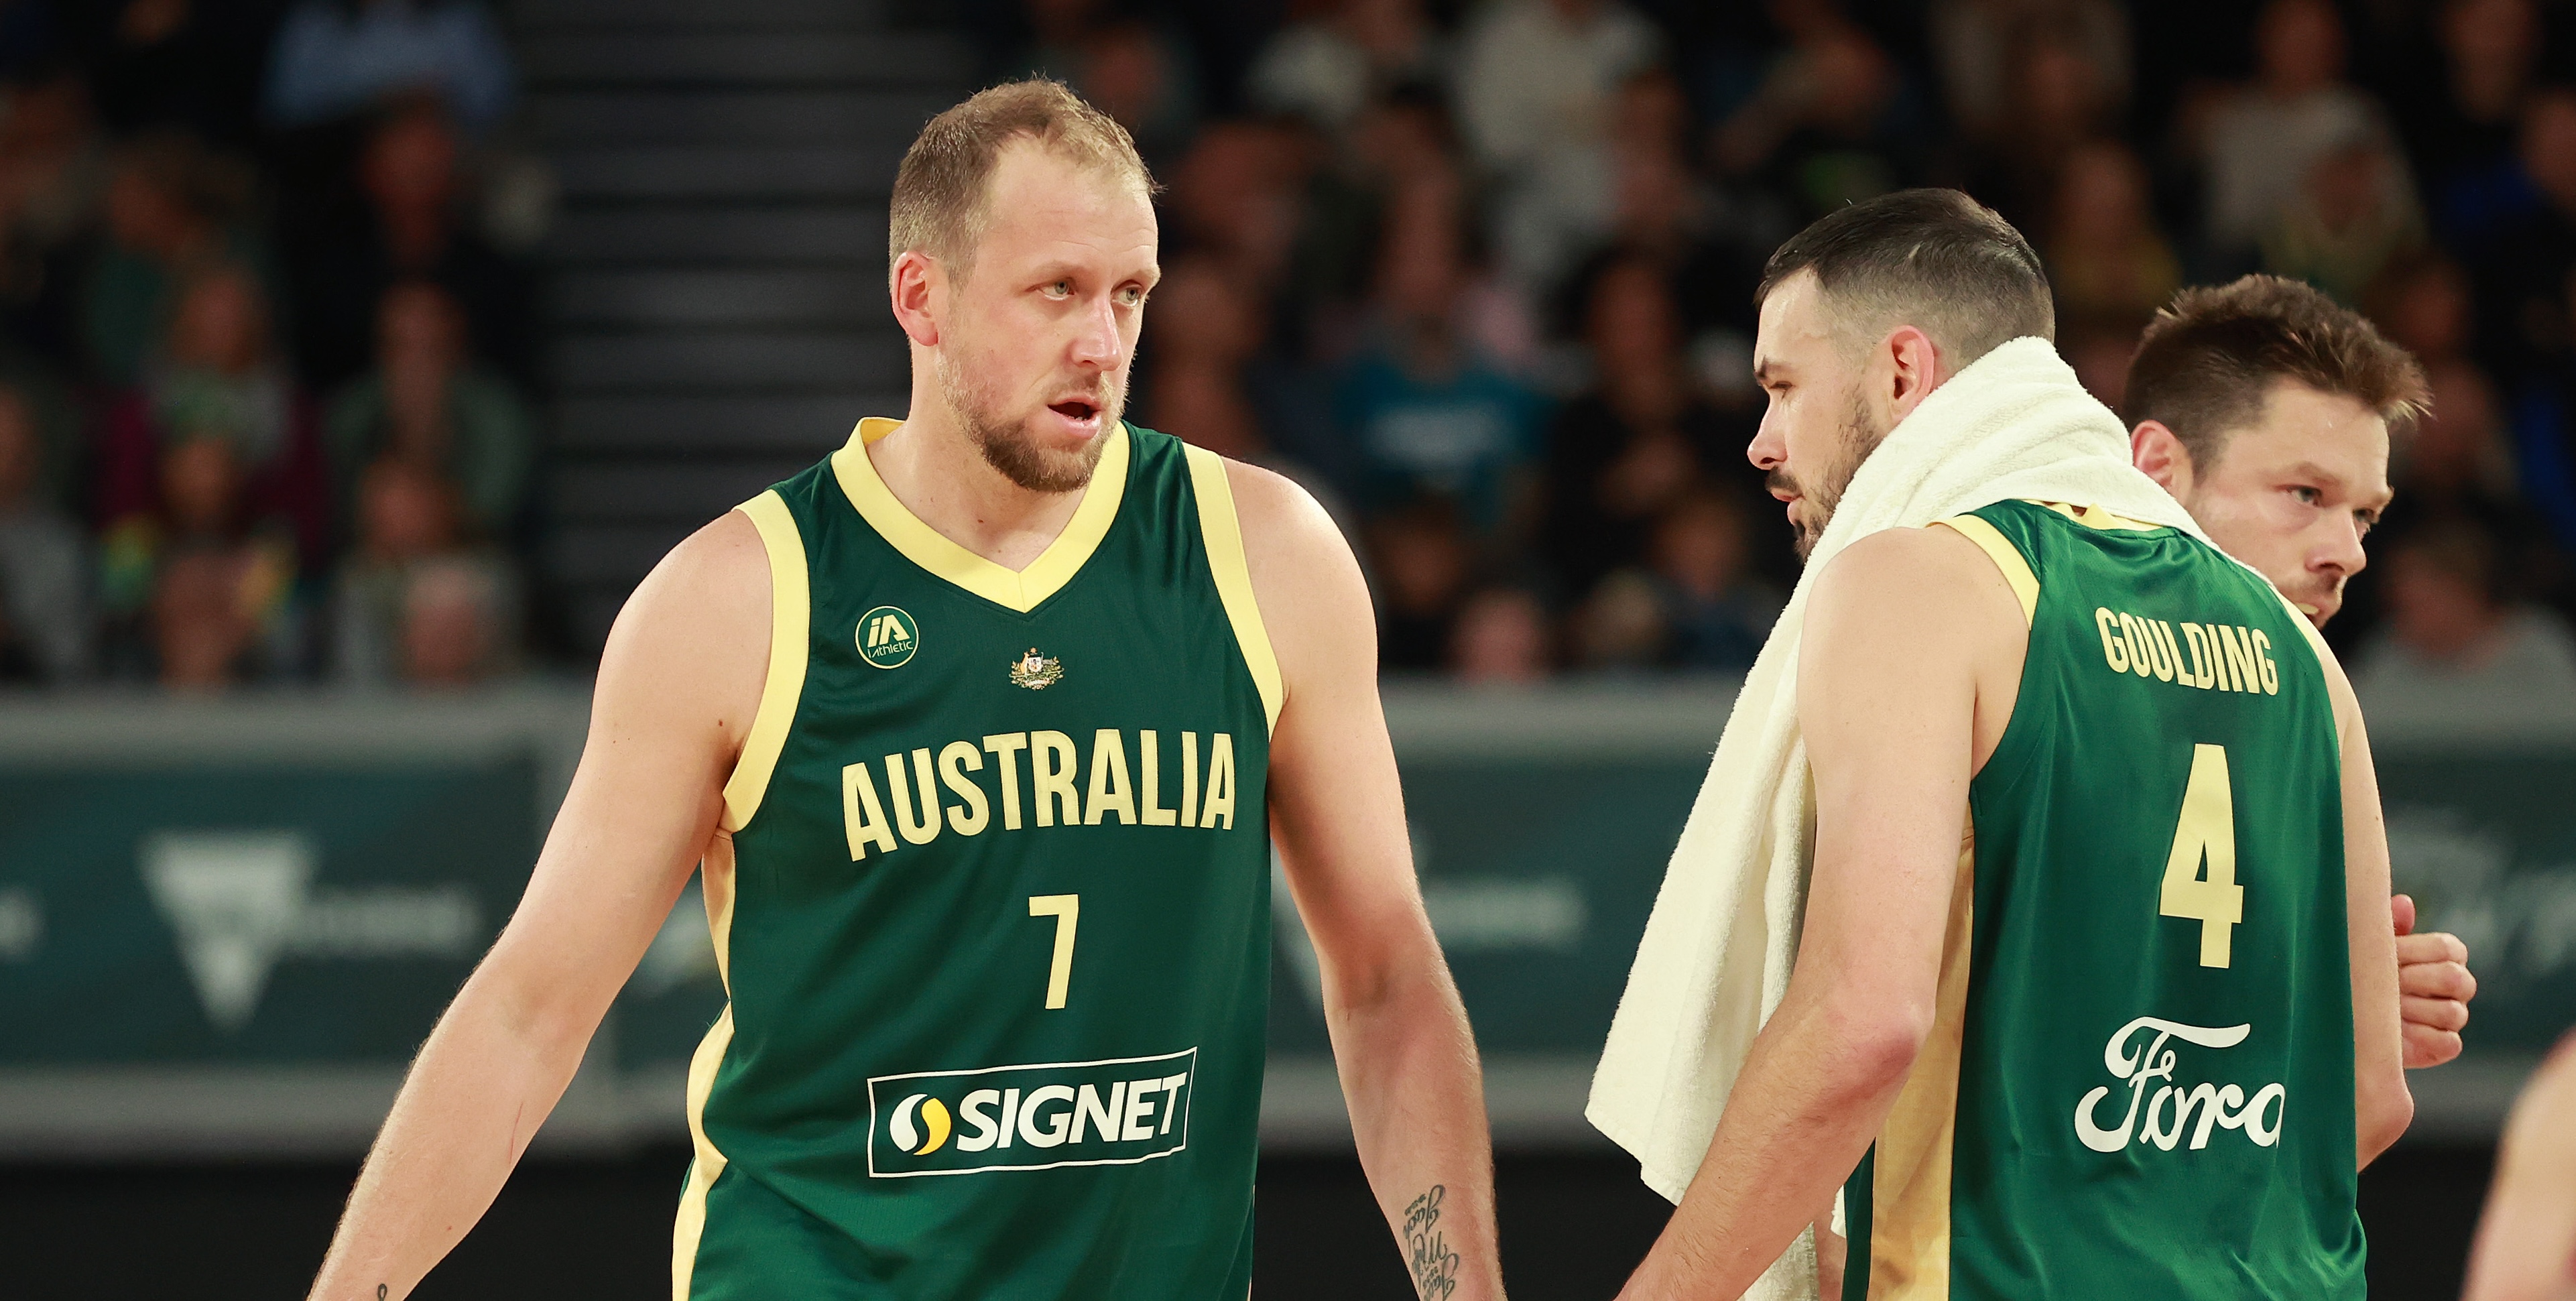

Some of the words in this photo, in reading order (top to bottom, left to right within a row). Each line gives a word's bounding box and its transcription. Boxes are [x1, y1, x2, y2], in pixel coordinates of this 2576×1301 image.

[2095, 607, 2279, 696] GOULDING
[842, 728, 1235, 862] AUSTRALIA
[2159, 743, 2244, 969] 4
[1029, 893, 1079, 1009] 7
[957, 1072, 1187, 1152] SIGNET
